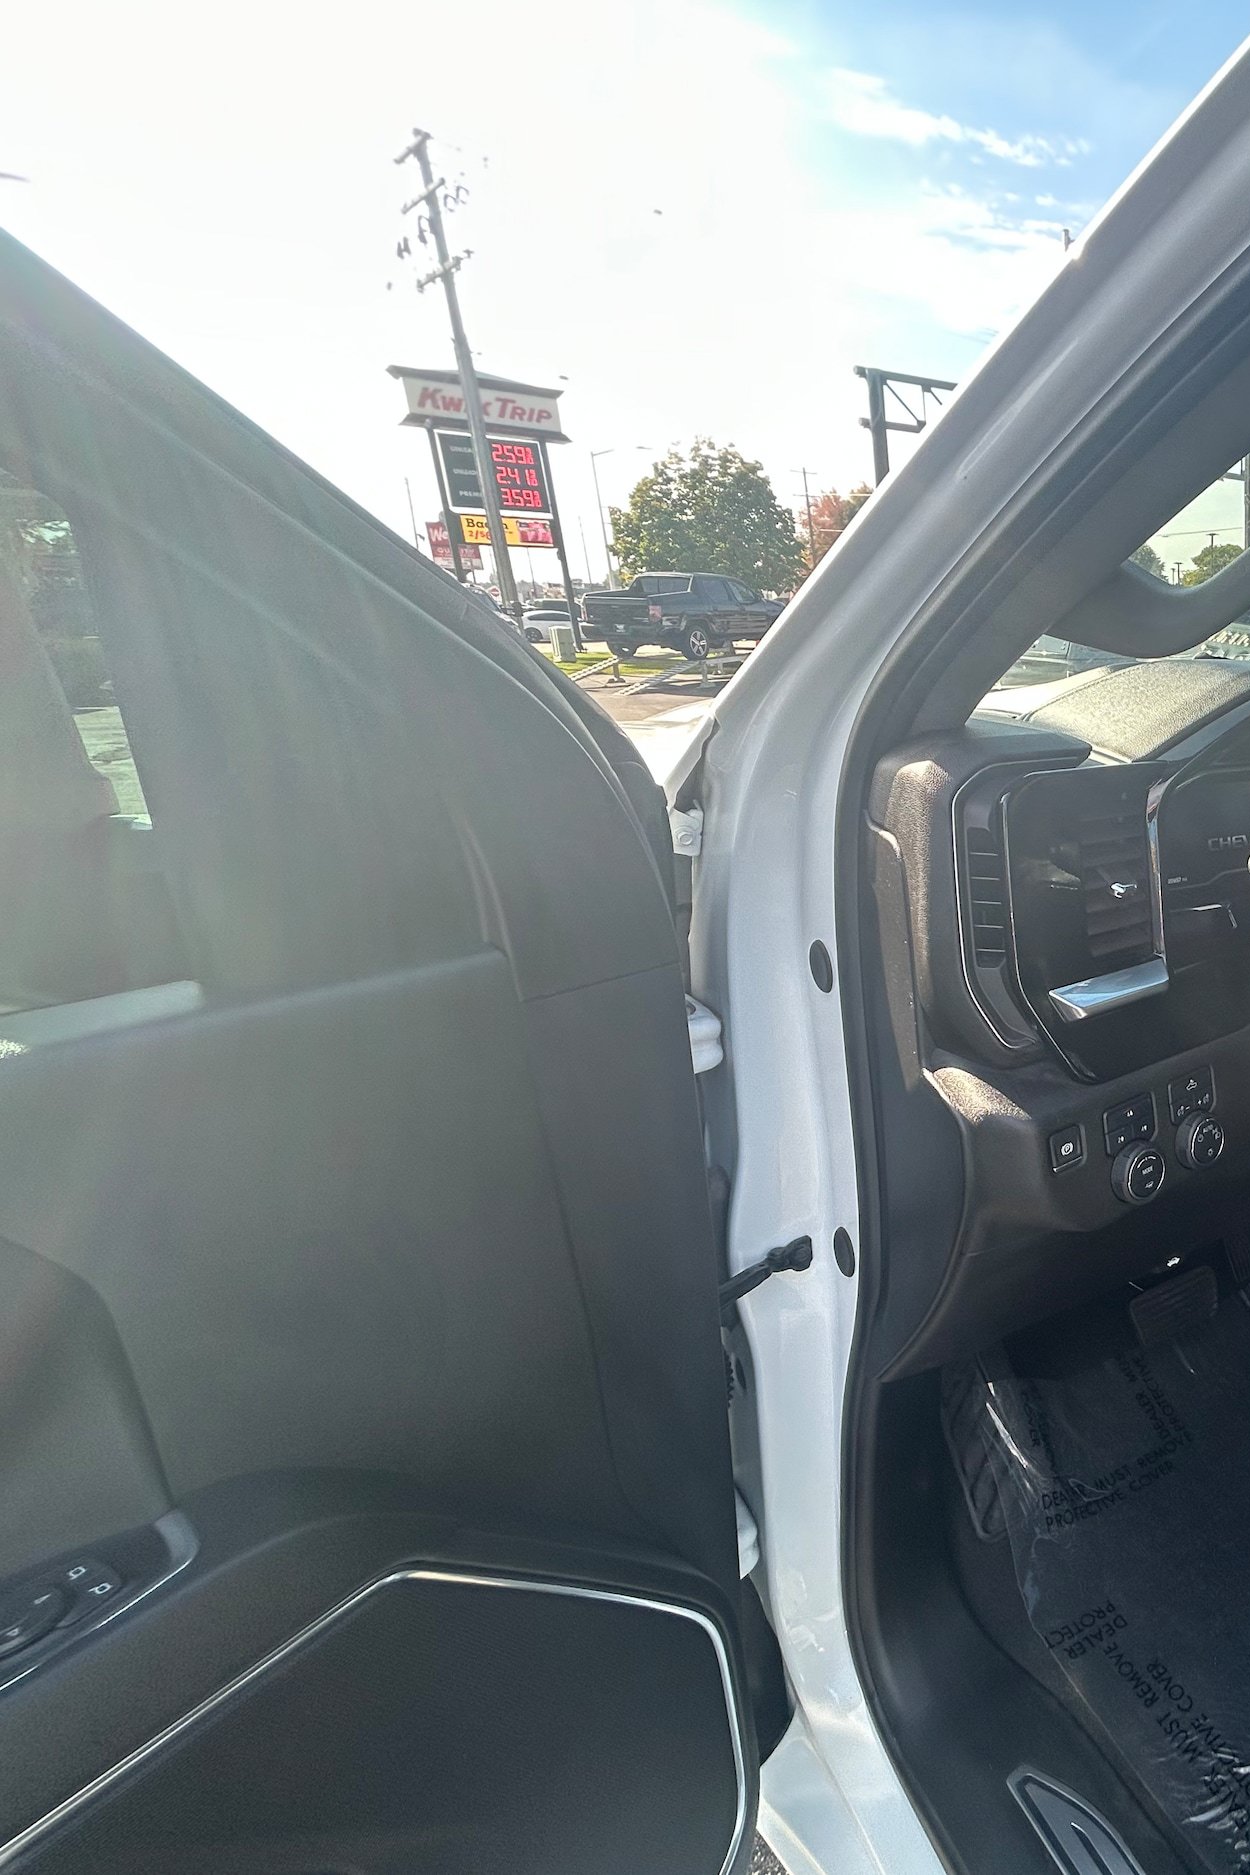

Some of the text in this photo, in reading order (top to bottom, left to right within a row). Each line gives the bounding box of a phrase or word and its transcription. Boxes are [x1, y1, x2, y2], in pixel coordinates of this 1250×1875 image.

[417, 387, 553, 423] KWK TRIP
[1044, 1460, 1174, 1532] PROTECTIVE COVER
[1093, 1464, 1131, 1491] MUST
[1063, 1613, 1129, 1660] DEALER
[1103, 1644, 1160, 1709] REMOVE
[1145, 1657, 1194, 1713] COVER
